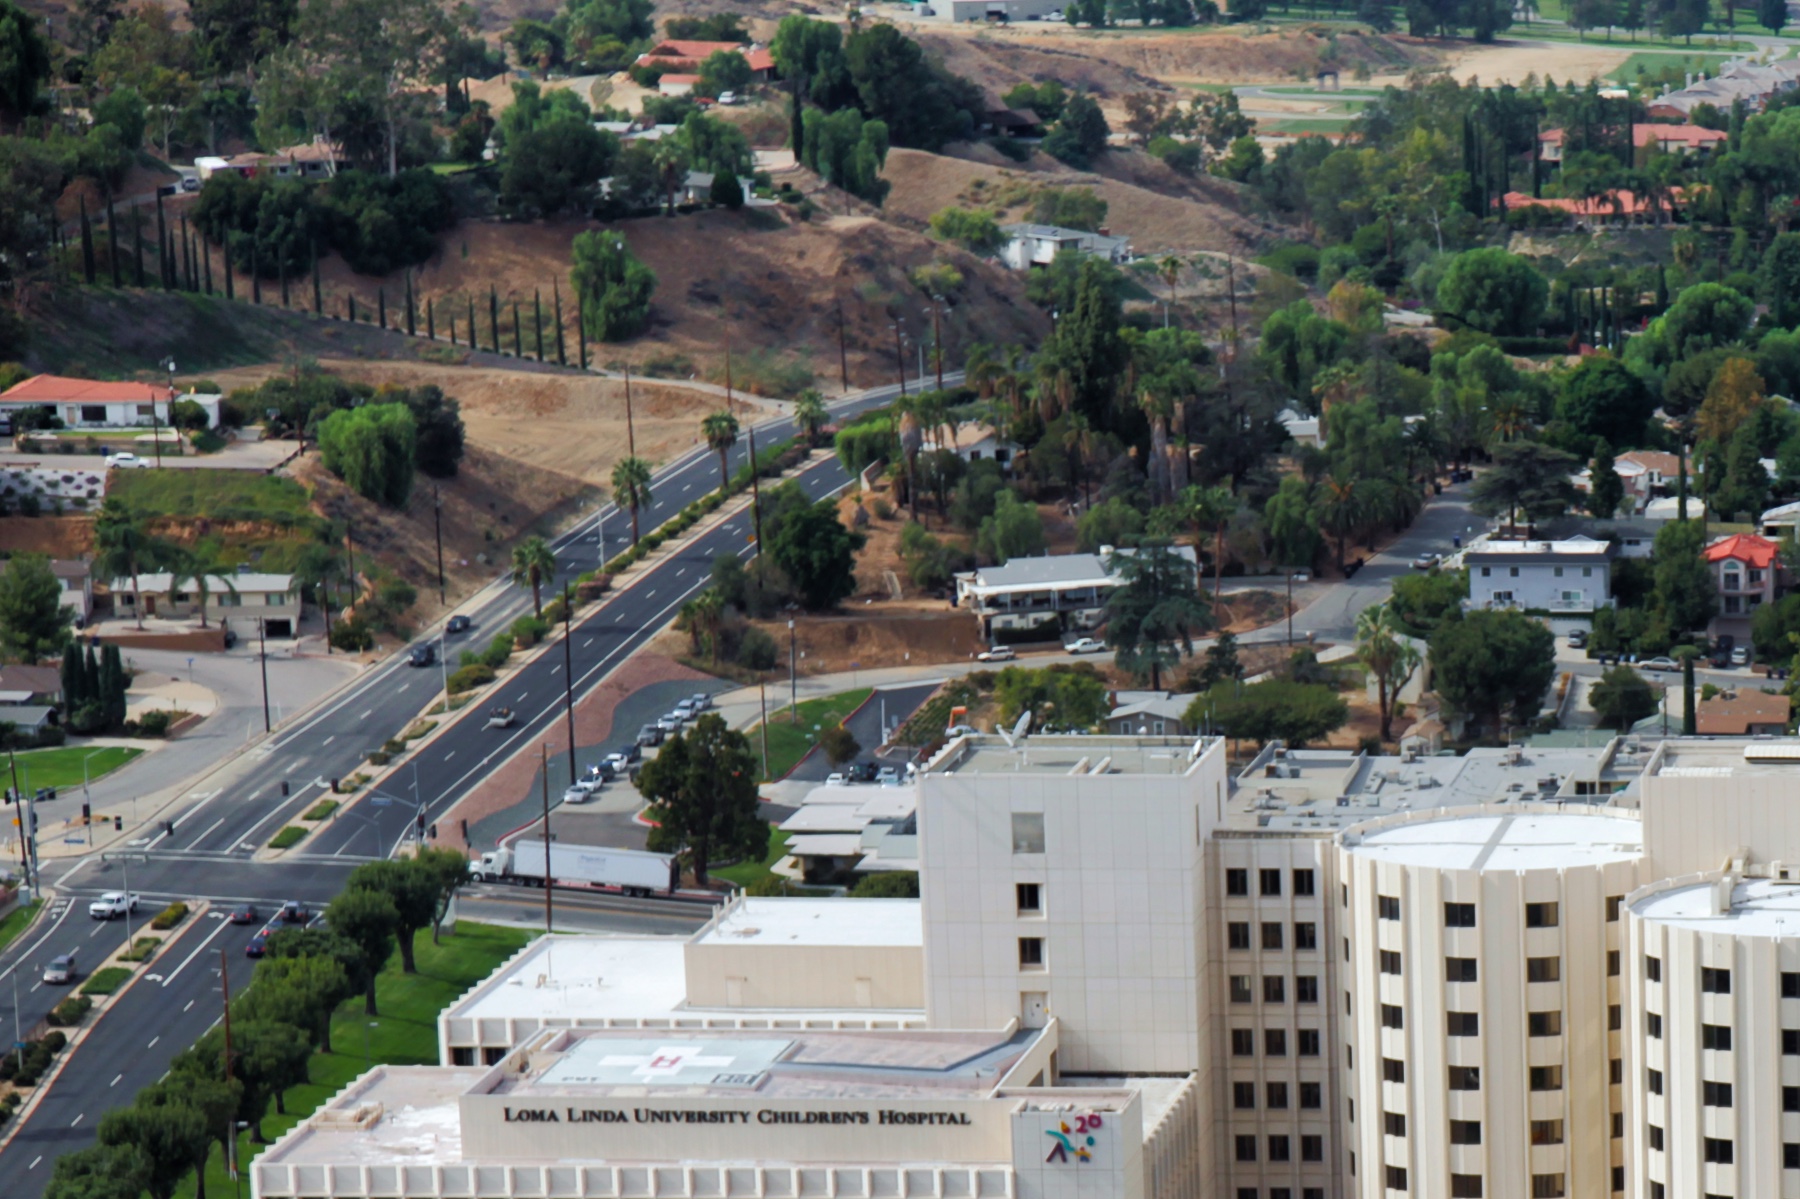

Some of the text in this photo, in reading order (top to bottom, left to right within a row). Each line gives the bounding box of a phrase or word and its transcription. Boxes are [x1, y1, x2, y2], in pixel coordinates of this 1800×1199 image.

[503, 1107, 971, 1126] LOMA LINDA UNIVERSITY CHILDREN'S HOSPITAL
[1075, 1114, 1102, 1133] 20
